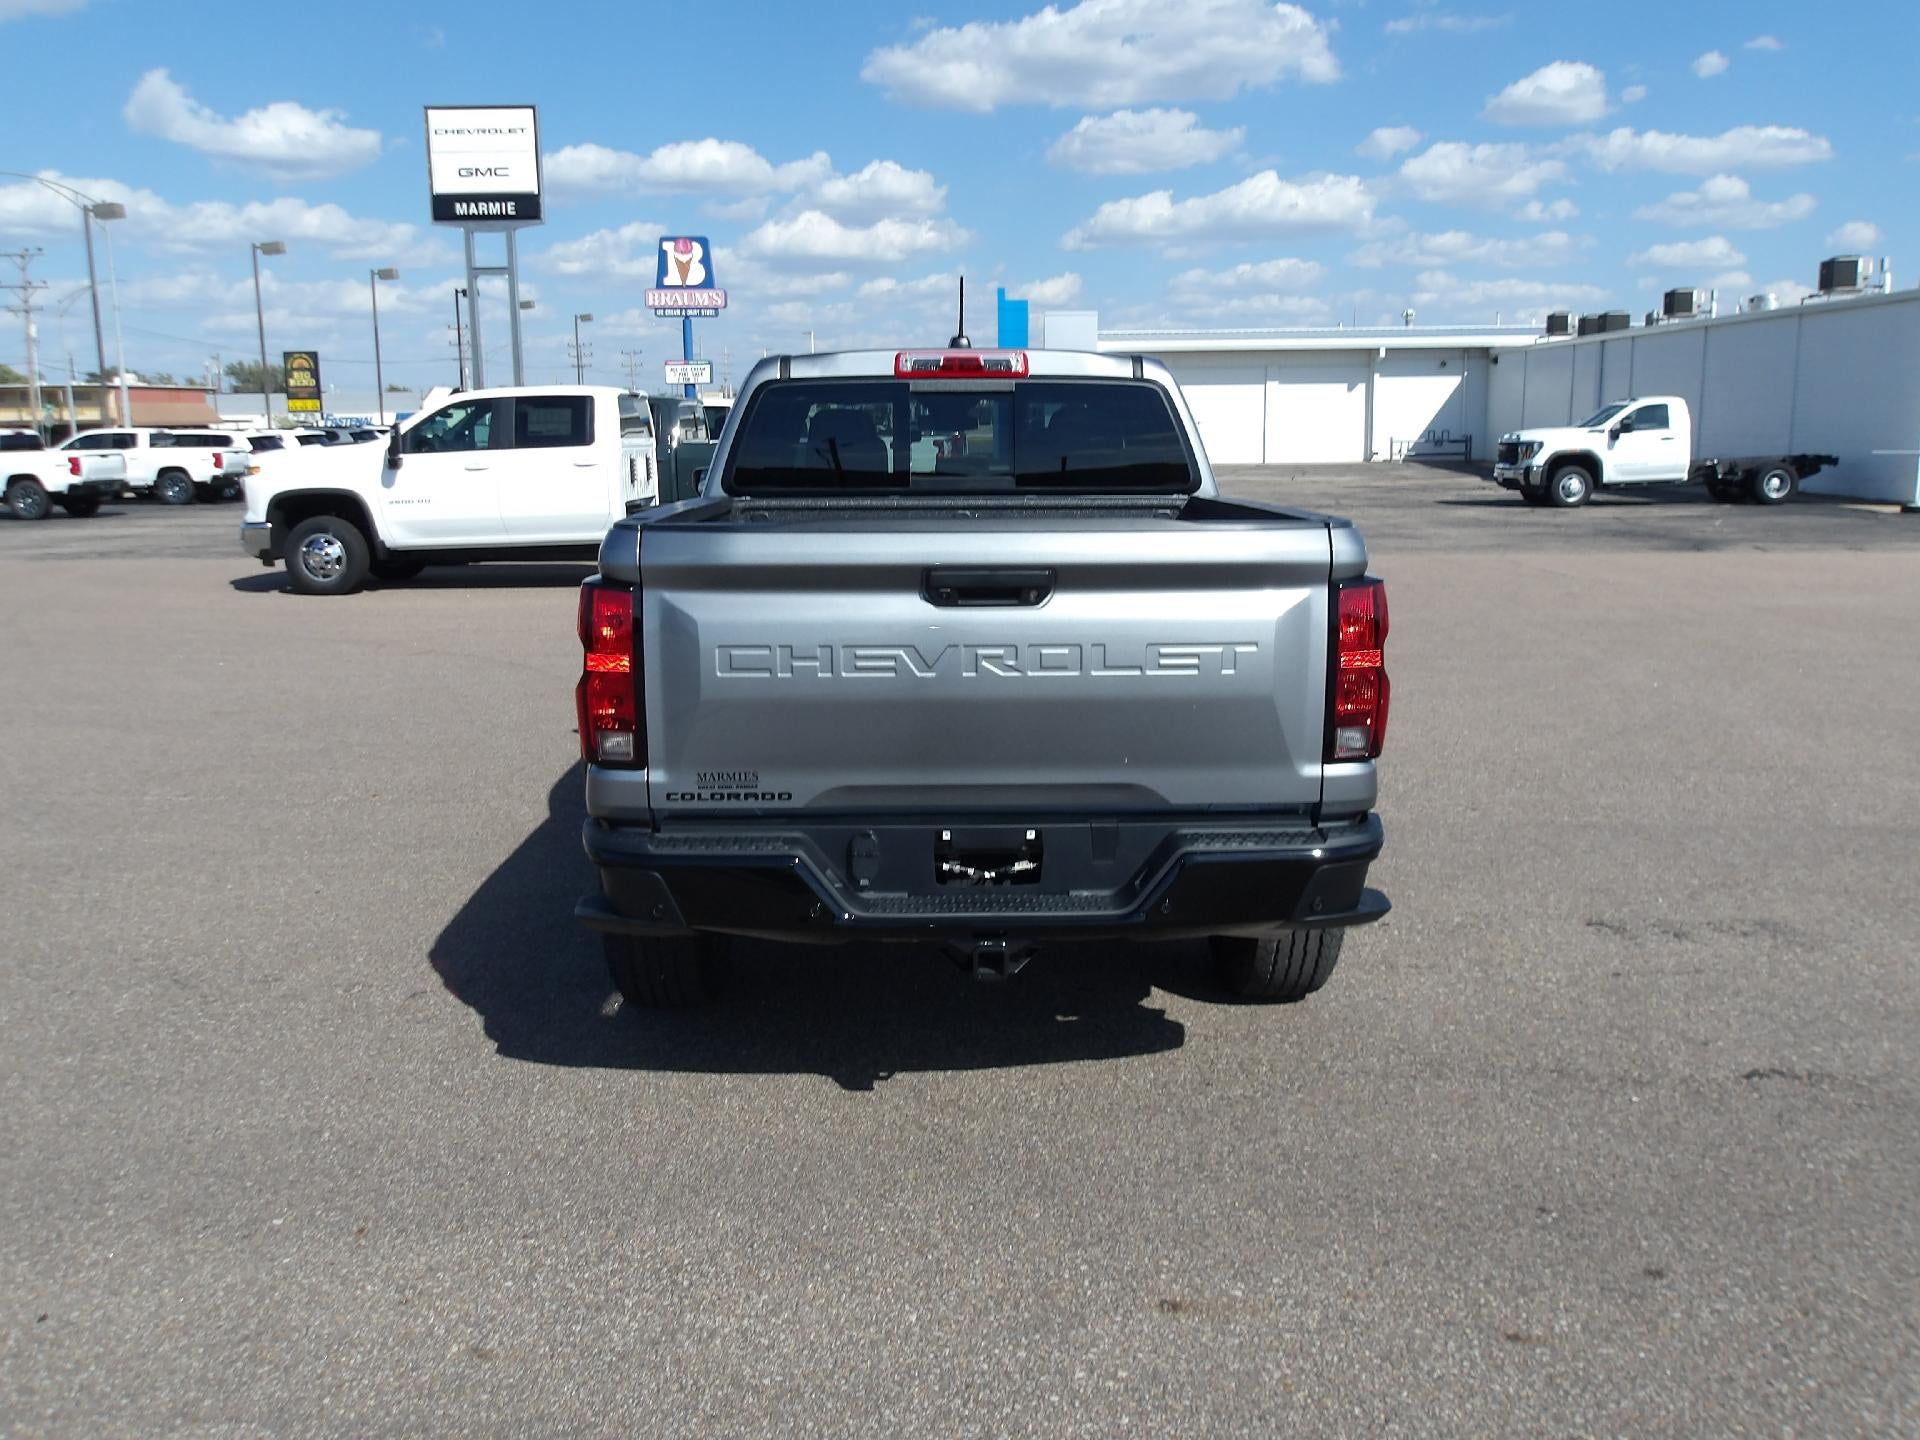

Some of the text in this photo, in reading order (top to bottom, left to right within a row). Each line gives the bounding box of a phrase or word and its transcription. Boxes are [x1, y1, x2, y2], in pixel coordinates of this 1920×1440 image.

[434, 127, 527, 136] CHEVROLET
[458, 167, 510, 177] GMC
[454, 201, 517, 216] MARMIE
[648, 291, 722, 306] BRAUM'S
[292, 370, 311, 380] BIG
[288, 379, 316, 387] BEND
[716, 643, 1258, 678] CHEVROLET
[665, 792, 792, 801] COLORADO
